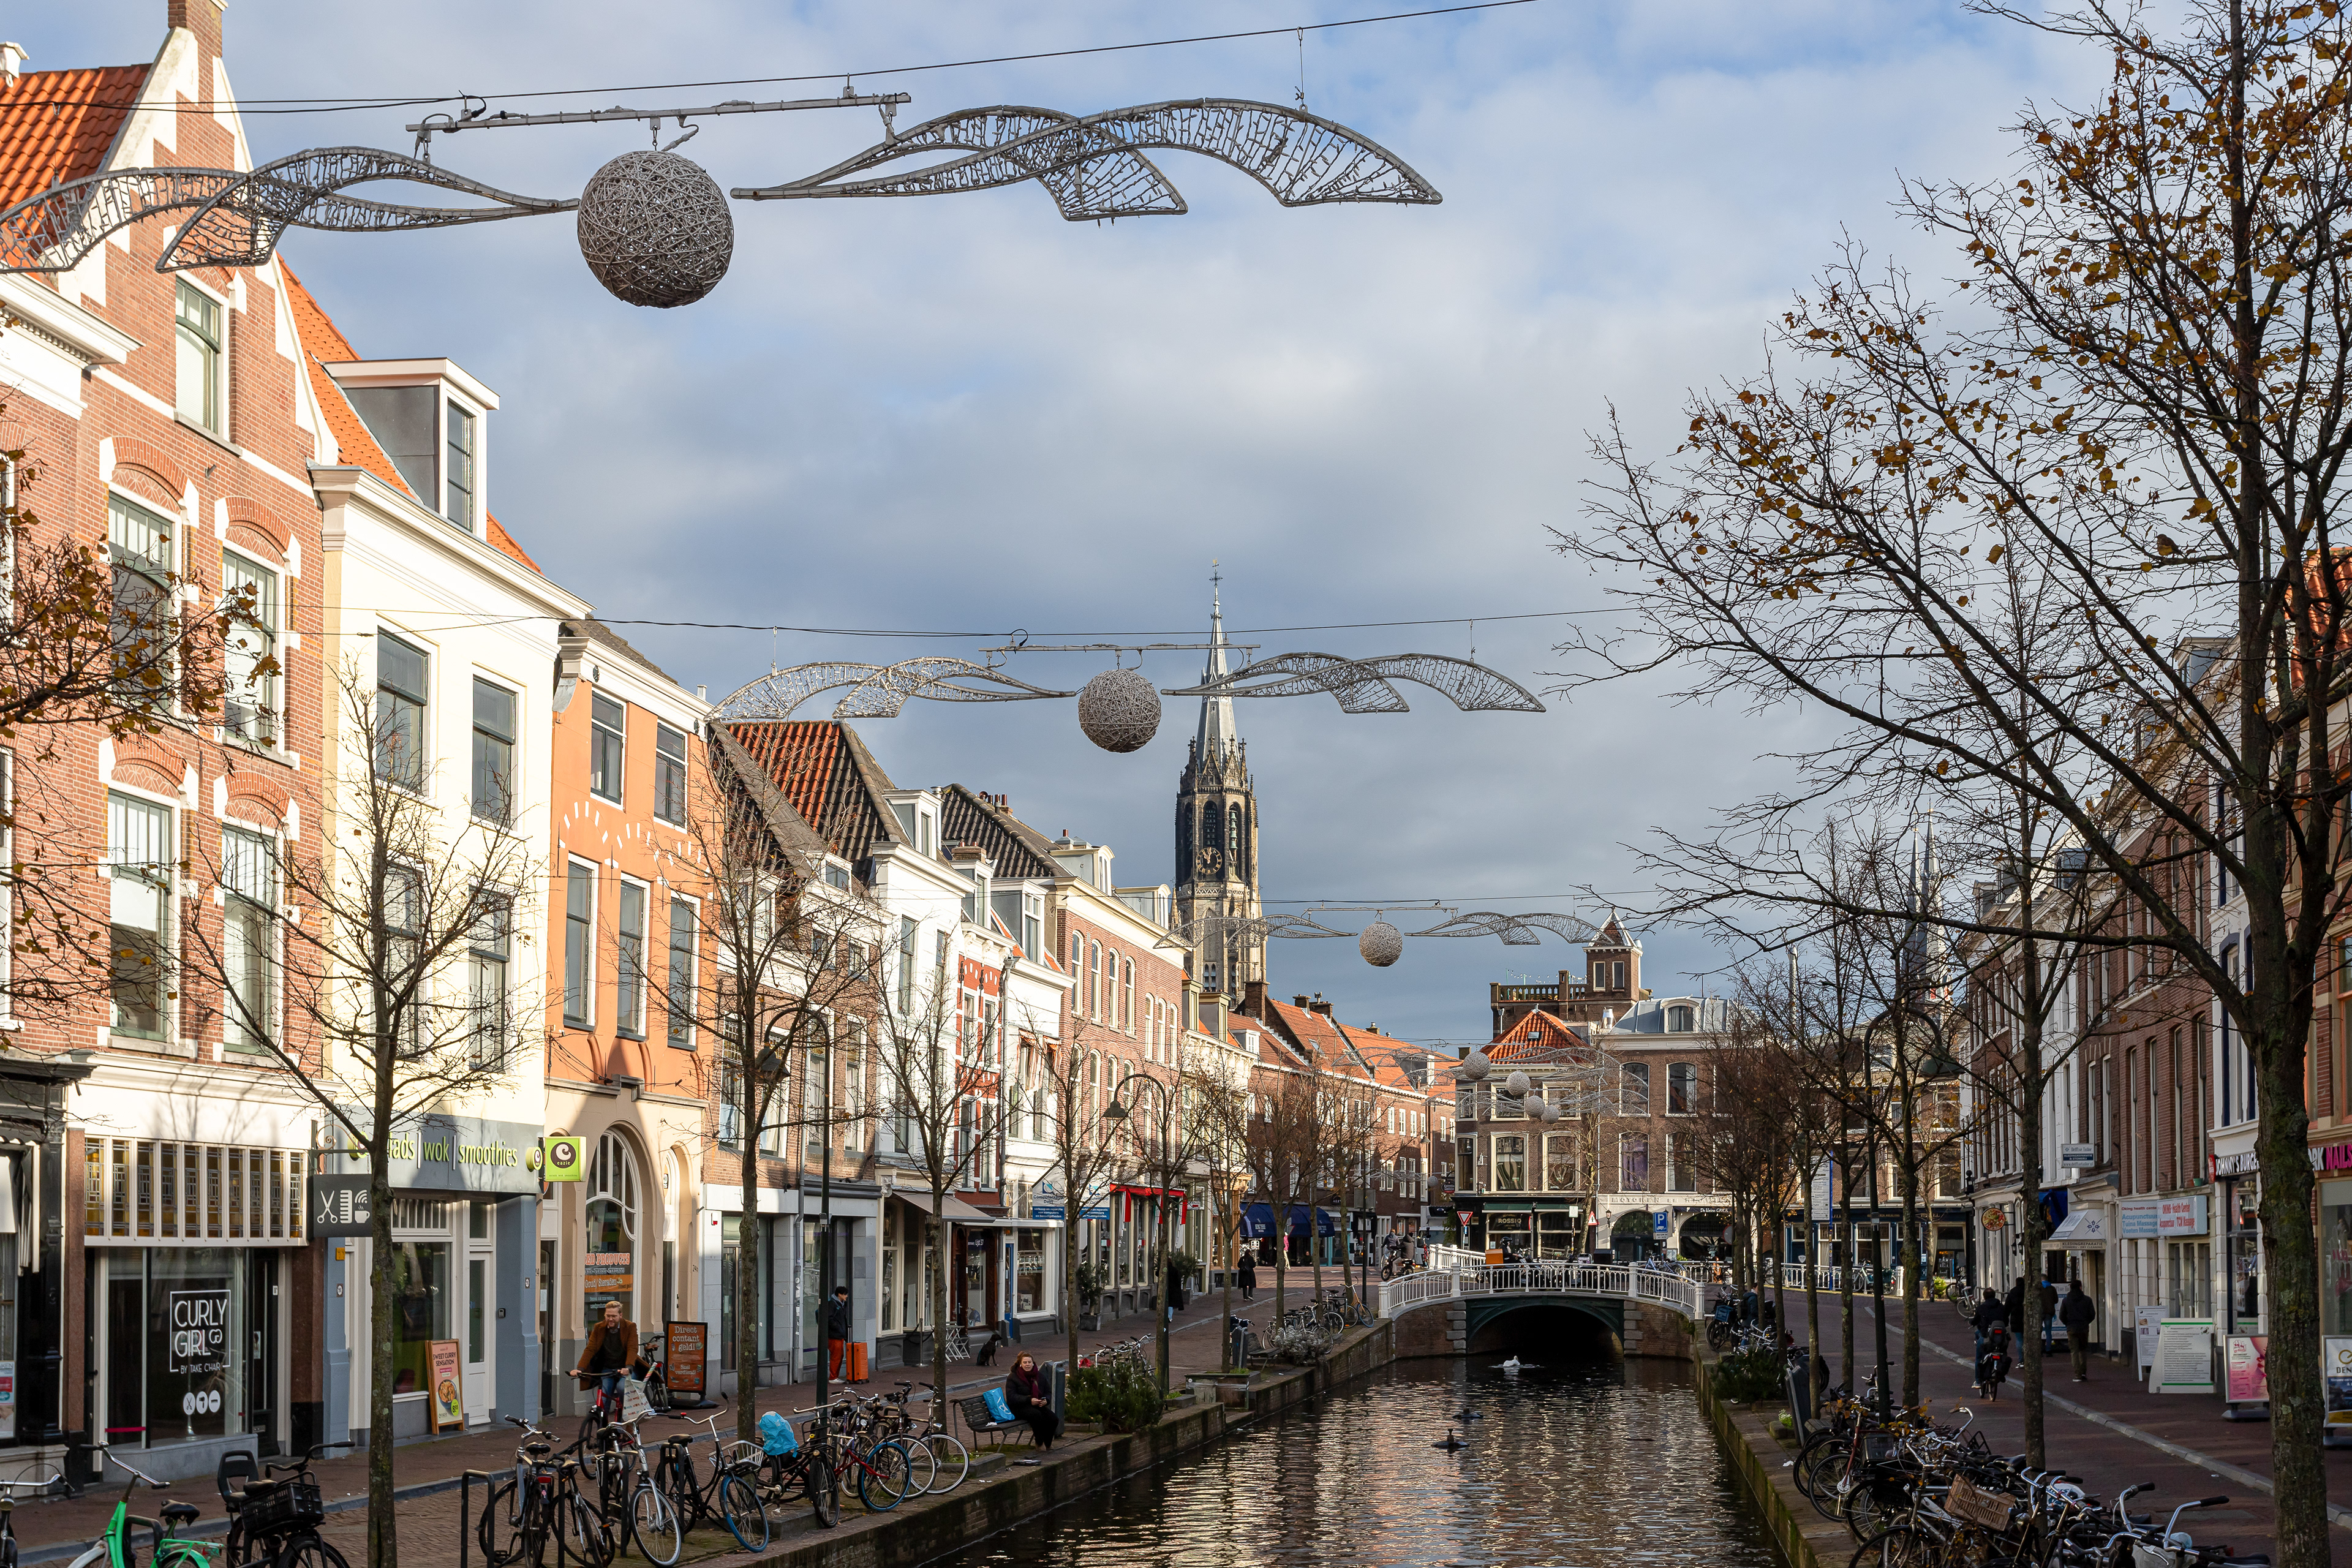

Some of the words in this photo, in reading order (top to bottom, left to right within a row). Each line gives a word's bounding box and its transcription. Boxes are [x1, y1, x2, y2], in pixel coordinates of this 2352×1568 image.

[424, 1136, 450, 1162] wok
[458, 1140, 518, 1167] smoothies
[2326, 1144, 2352, 1170] NAILS
[2215, 1155, 2239, 1176] JOHNNY'S
[1657, 1214, 1665, 1224] P
[596, 1253, 630, 1265] PRODUCTS
[175, 1299, 227, 1327] CURLY
[175, 1329, 211, 1357] GIRL
[678, 1343, 695, 1352] geld!
[180, 1365, 187, 1374] BY
[190, 1363, 202, 1373] TAKE
